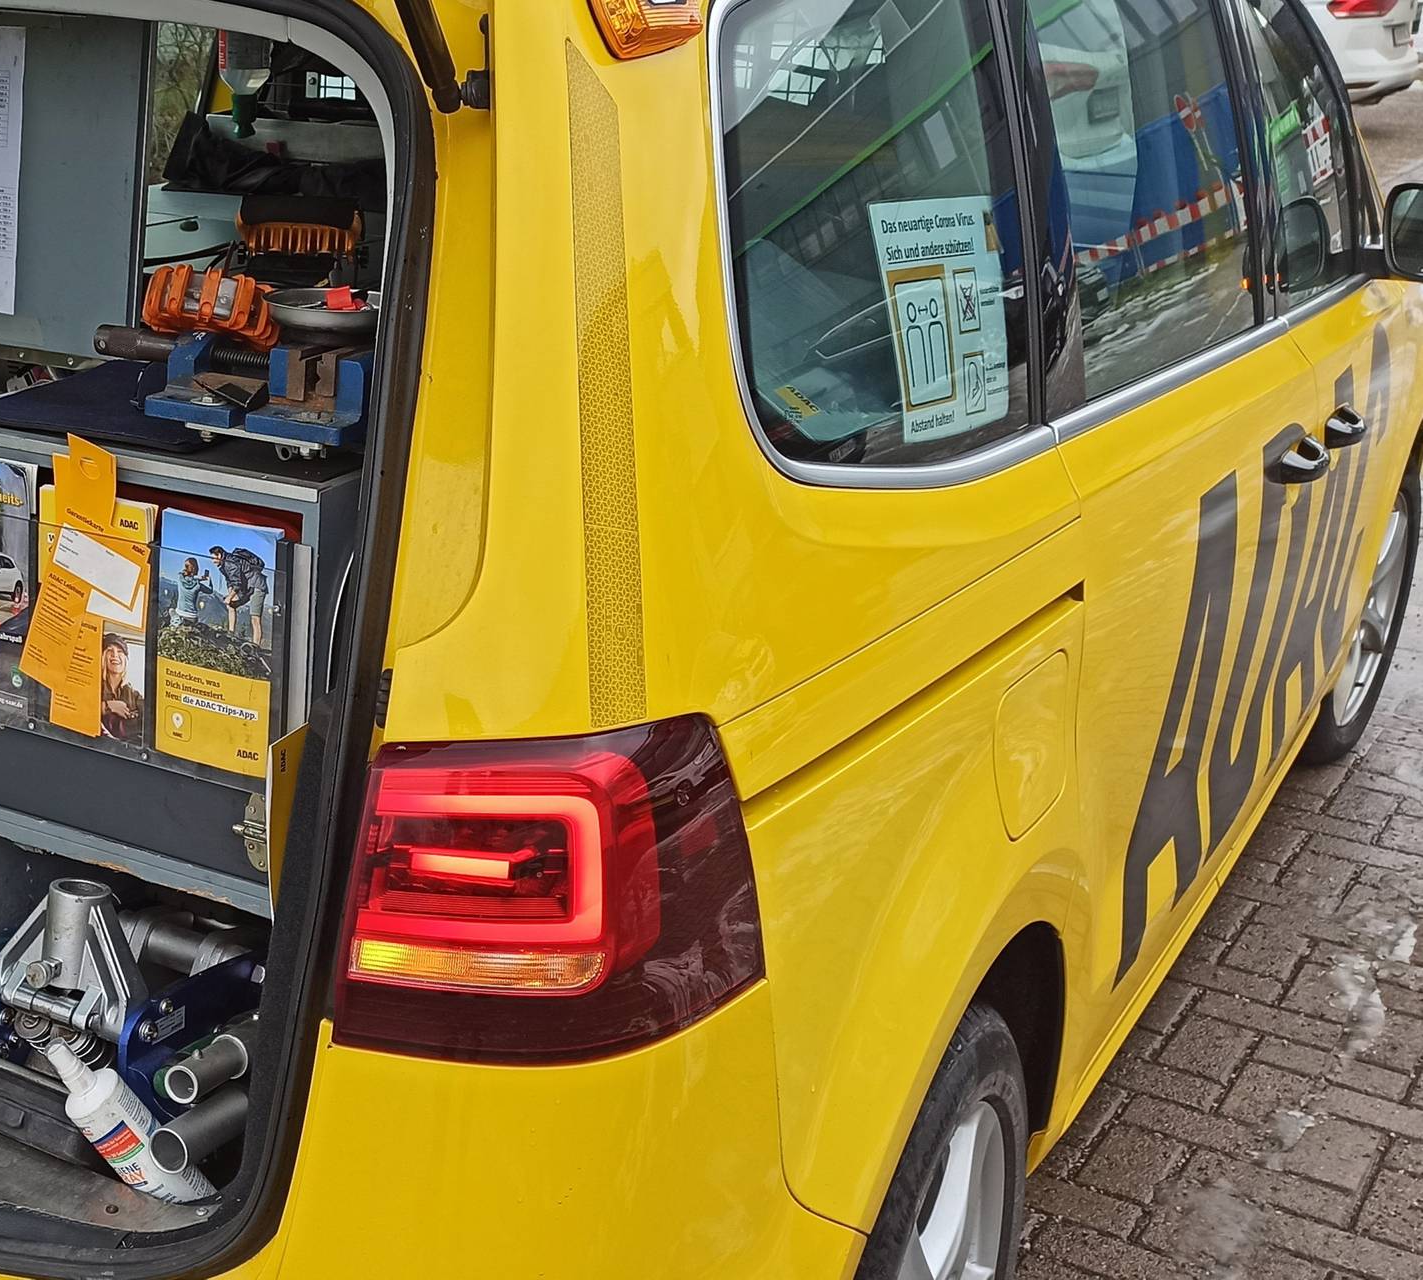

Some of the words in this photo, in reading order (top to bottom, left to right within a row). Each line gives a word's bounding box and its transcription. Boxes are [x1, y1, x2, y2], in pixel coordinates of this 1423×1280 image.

[881, 219, 897, 234] Das
[898, 215, 934, 233] neuartige
[934, 214, 956, 229] Corona
[886, 245, 903, 261] Sich
[904, 242, 919, 259] und
[920, 240, 944, 257] andere
[944, 237, 974, 255] schützen!
[910, 416, 934, 434] Abstand
[935, 409, 955, 428] halten!
[119, 518, 139, 531] ADAC
[1112, 321, 1391, 994] ADAC
[165, 668, 204, 685] Entdecken,
[206, 678, 220, 688] was
[165, 679, 181, 690] Dich
[182, 682, 225, 701] interessiert.
[165, 691, 181, 701] Neu:
[183, 695, 194, 705] die
[195, 698, 217, 711] ADAC
[217, 702, 257, 720] Trips-App.
[237, 749, 259, 761] ADAC
